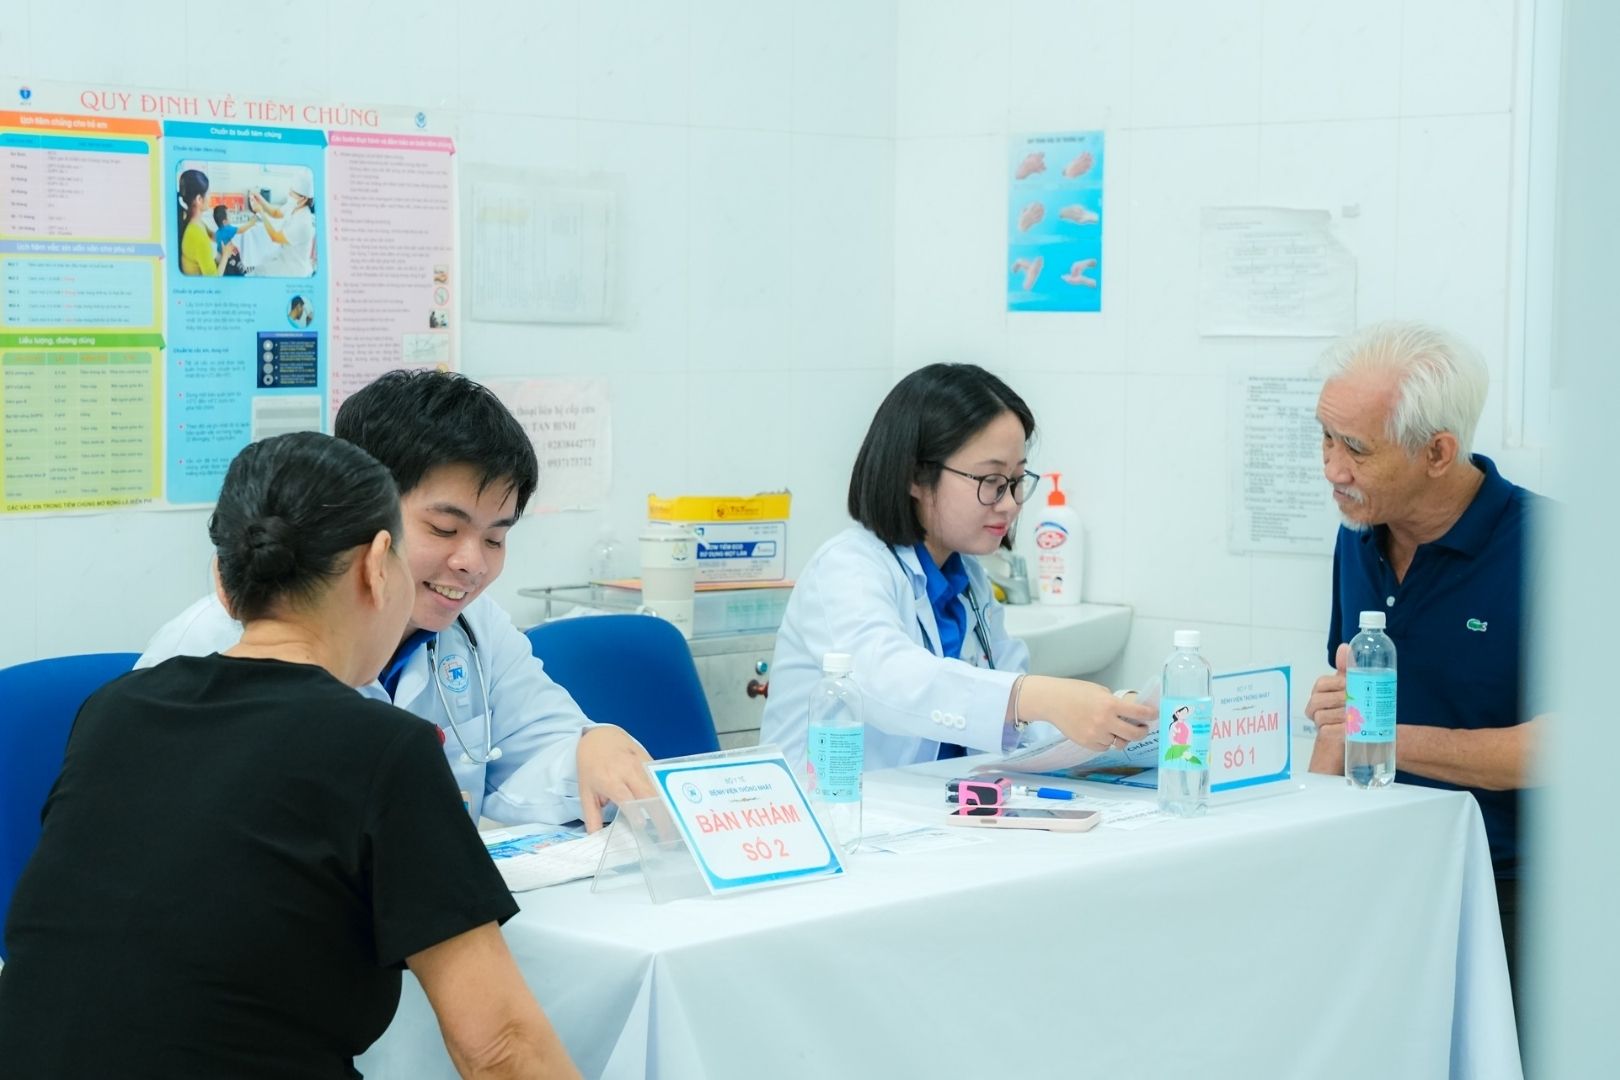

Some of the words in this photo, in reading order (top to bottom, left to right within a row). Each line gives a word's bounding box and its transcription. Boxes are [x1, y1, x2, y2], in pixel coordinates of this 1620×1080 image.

[79, 90, 131, 112] QUY
[140, 94, 198, 119] ĐỊNH
[207, 93, 237, 119] VỀ
[245, 99, 295, 123] TIÊM
[1211, 718, 1232, 740] ÀN
[1236, 708, 1279, 736] KHÁM
[1223, 747, 1244, 769] SỐ
[1248, 748, 1255, 765] 1
[695, 808, 741, 834] BÀN
[741, 802, 801, 828] KHÁM
[742, 836, 773, 862] SỐ
[774, 839, 790, 858] 2
